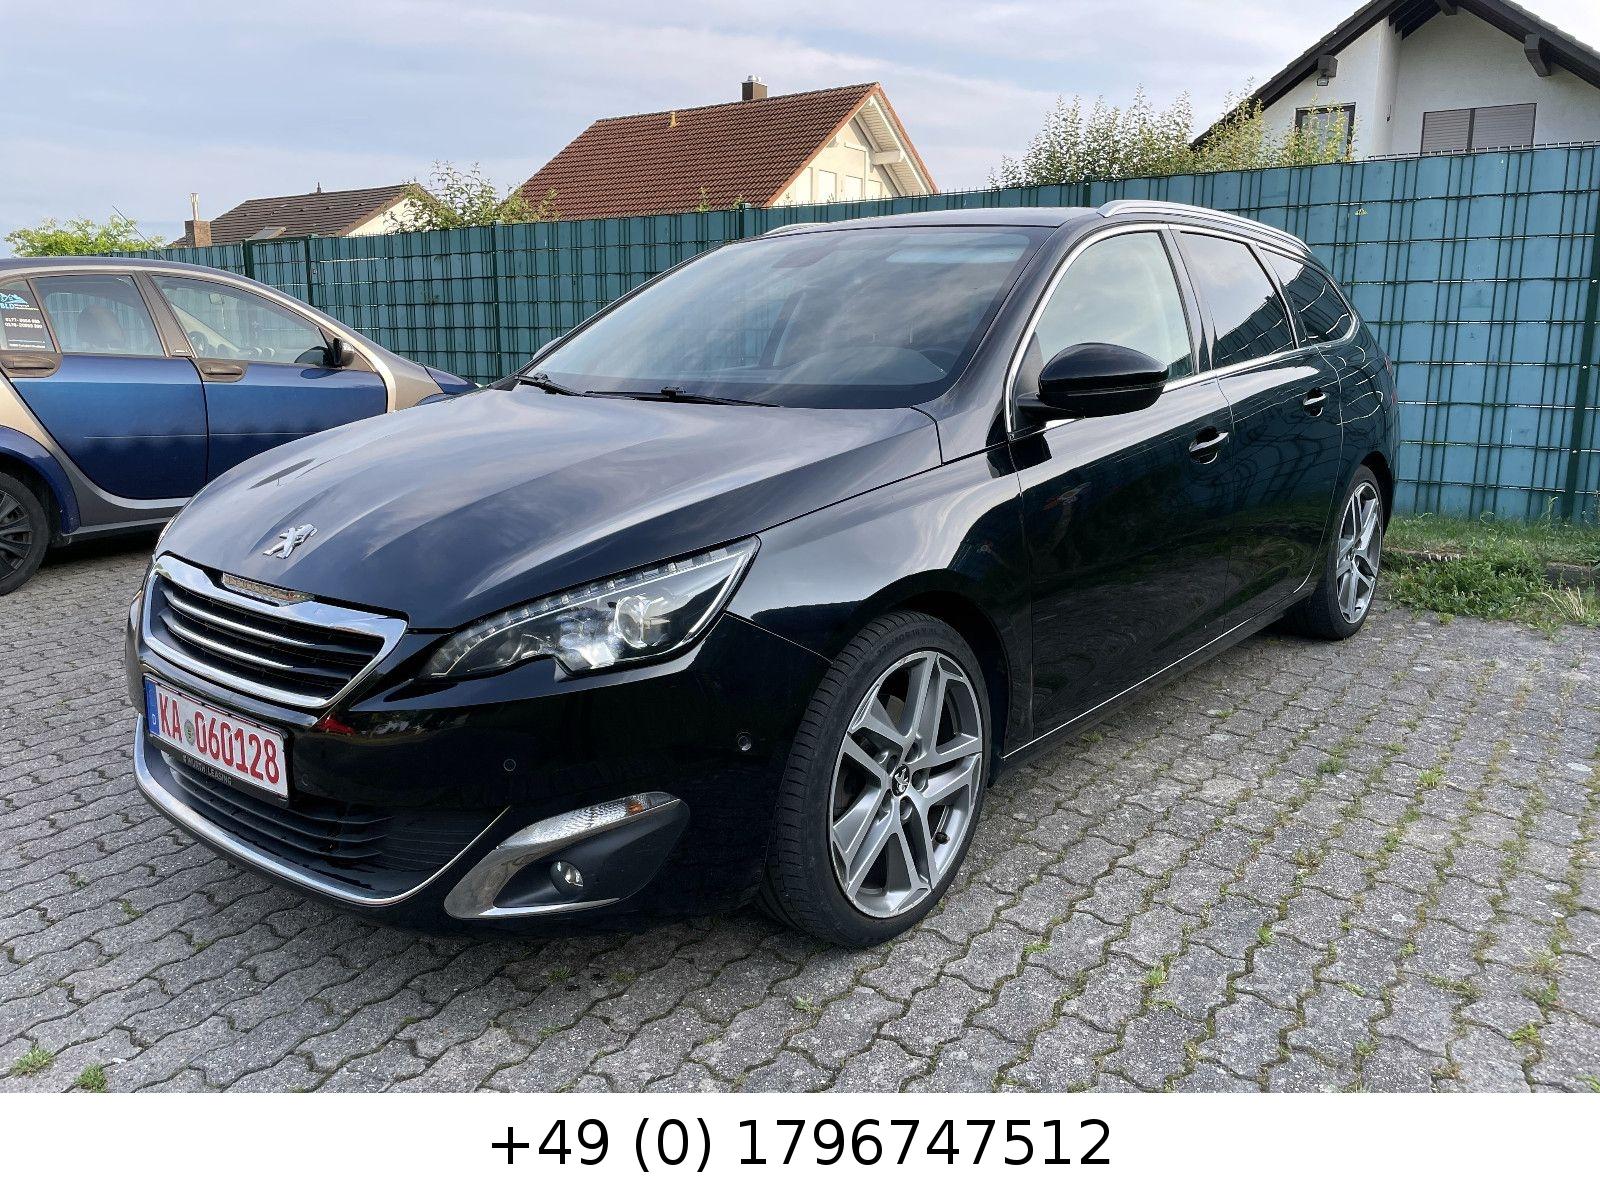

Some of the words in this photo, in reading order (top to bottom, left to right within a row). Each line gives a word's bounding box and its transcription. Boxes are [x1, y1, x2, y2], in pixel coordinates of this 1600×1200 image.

[152, 714, 157, 724] D
[159, 692, 182, 743] KA
[194, 710, 280, 784] 060128
